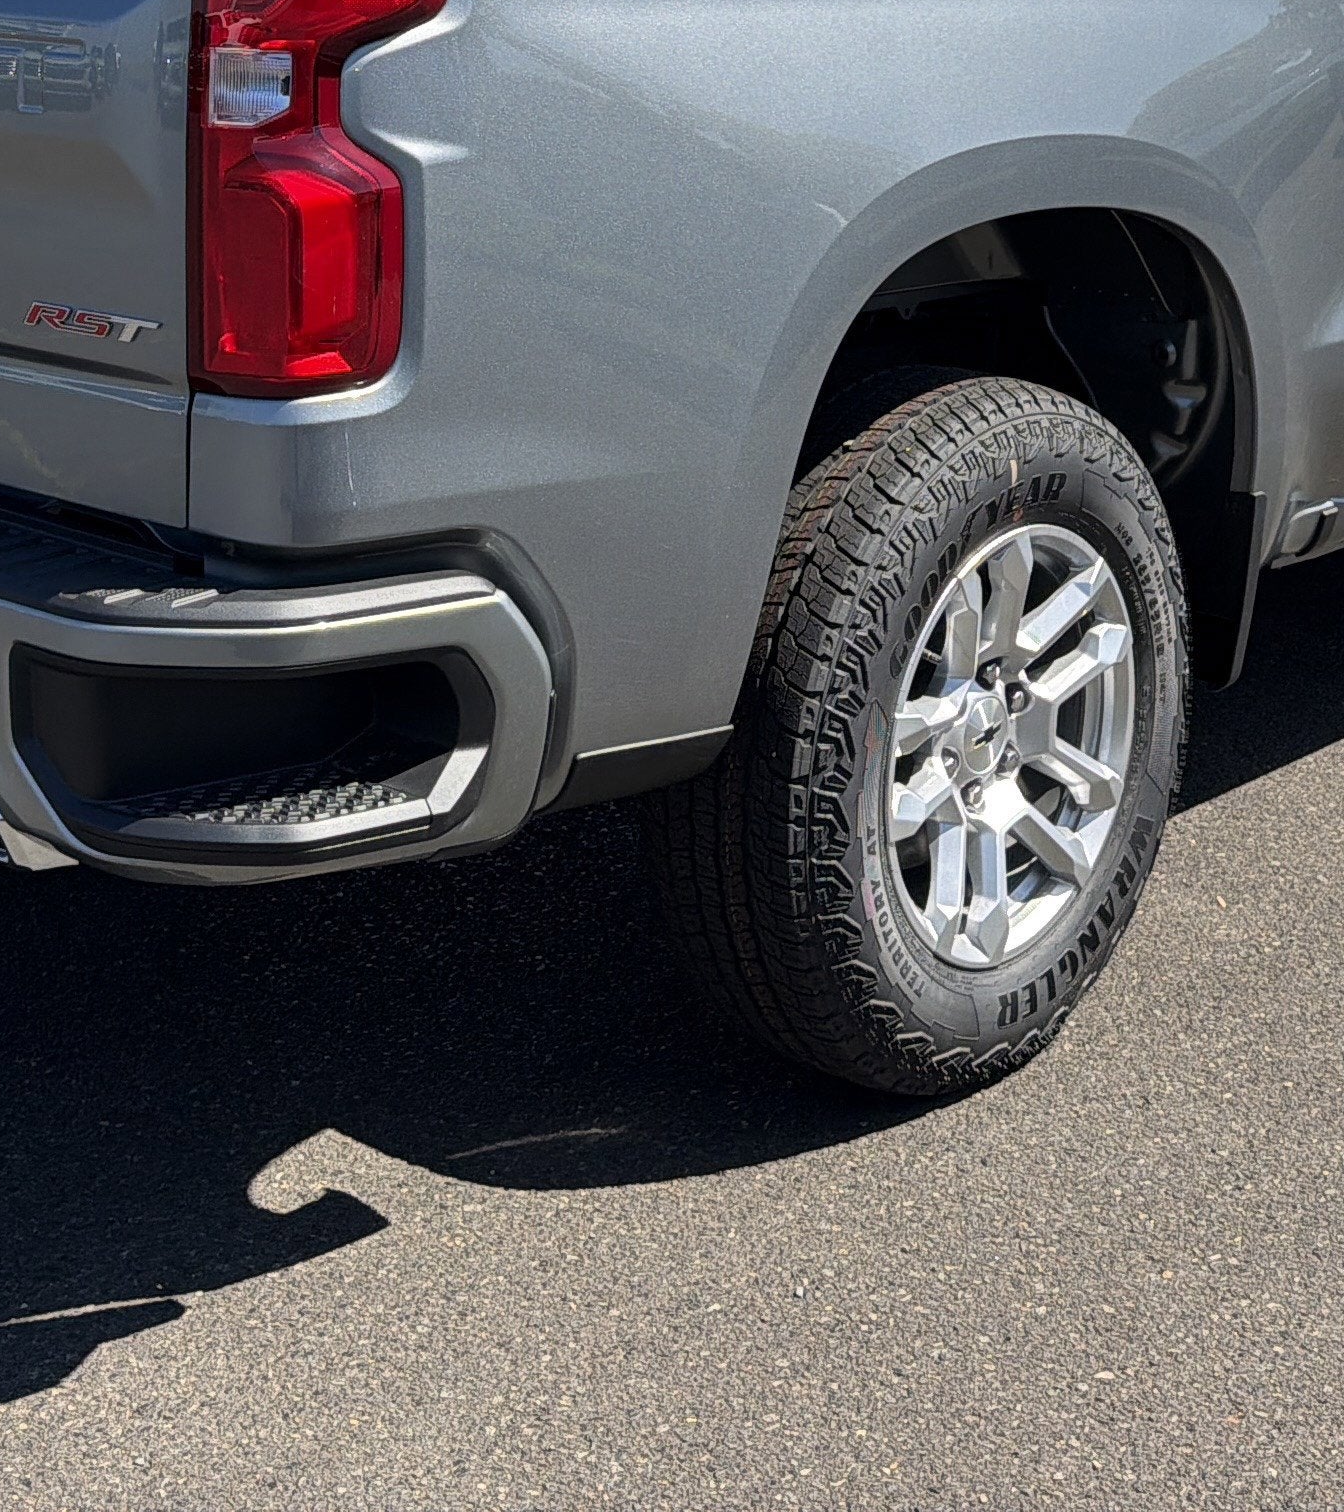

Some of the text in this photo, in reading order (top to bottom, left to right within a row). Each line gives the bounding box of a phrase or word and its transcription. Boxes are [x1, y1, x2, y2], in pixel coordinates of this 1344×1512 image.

[24, 300, 163, 343] RST
[890, 471, 1068, 680] GOODYEAR
[865, 824, 926, 999] TERRITORY AT
[997, 815, 1156, 1031] WRANGLER
